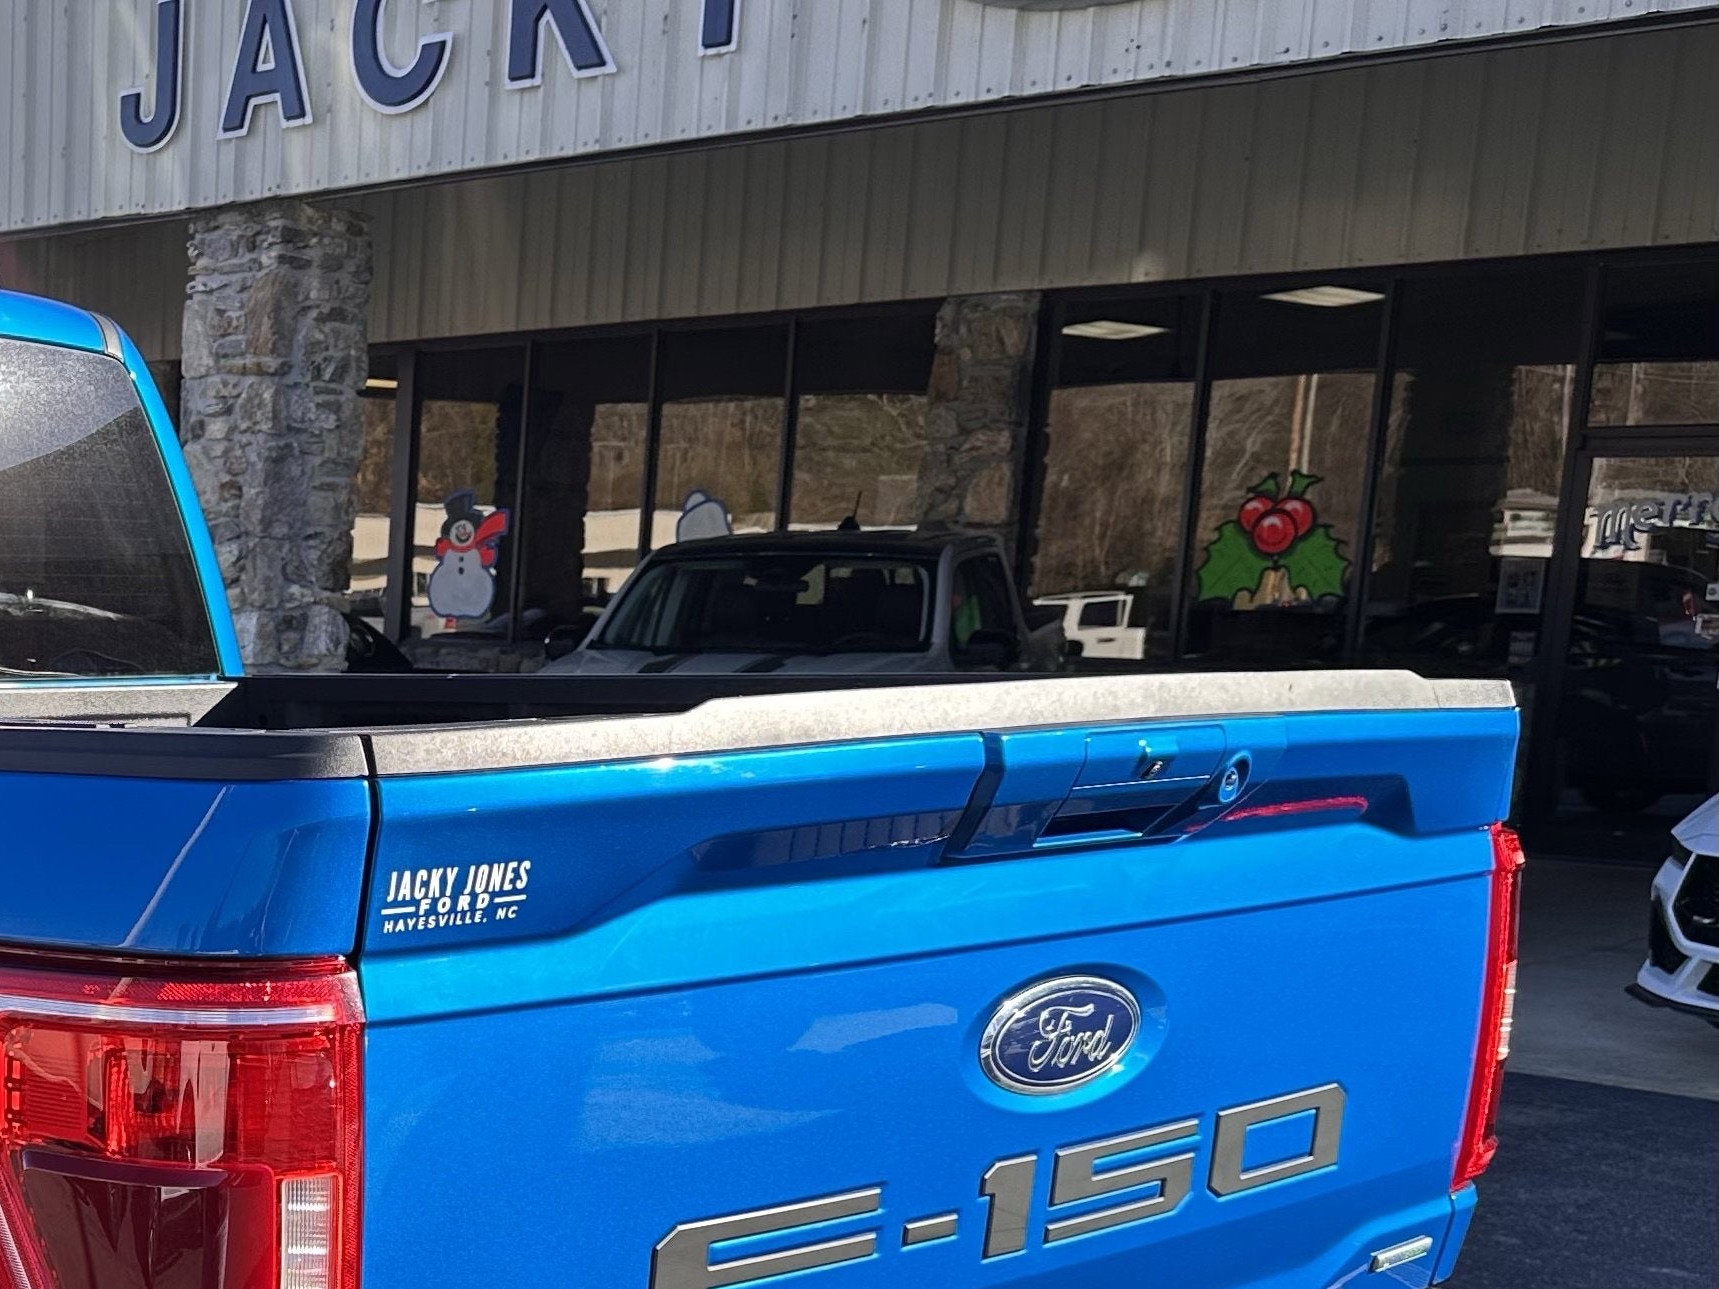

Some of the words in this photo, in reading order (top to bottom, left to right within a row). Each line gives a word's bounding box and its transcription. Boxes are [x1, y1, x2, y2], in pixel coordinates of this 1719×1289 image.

[387, 866, 459, 903] JACKY
[463, 860, 532, 895] JONES
[418, 893, 491, 916] FORD
[495, 905, 519, 921] NC
[1027, 1003, 1115, 1073] Ford
